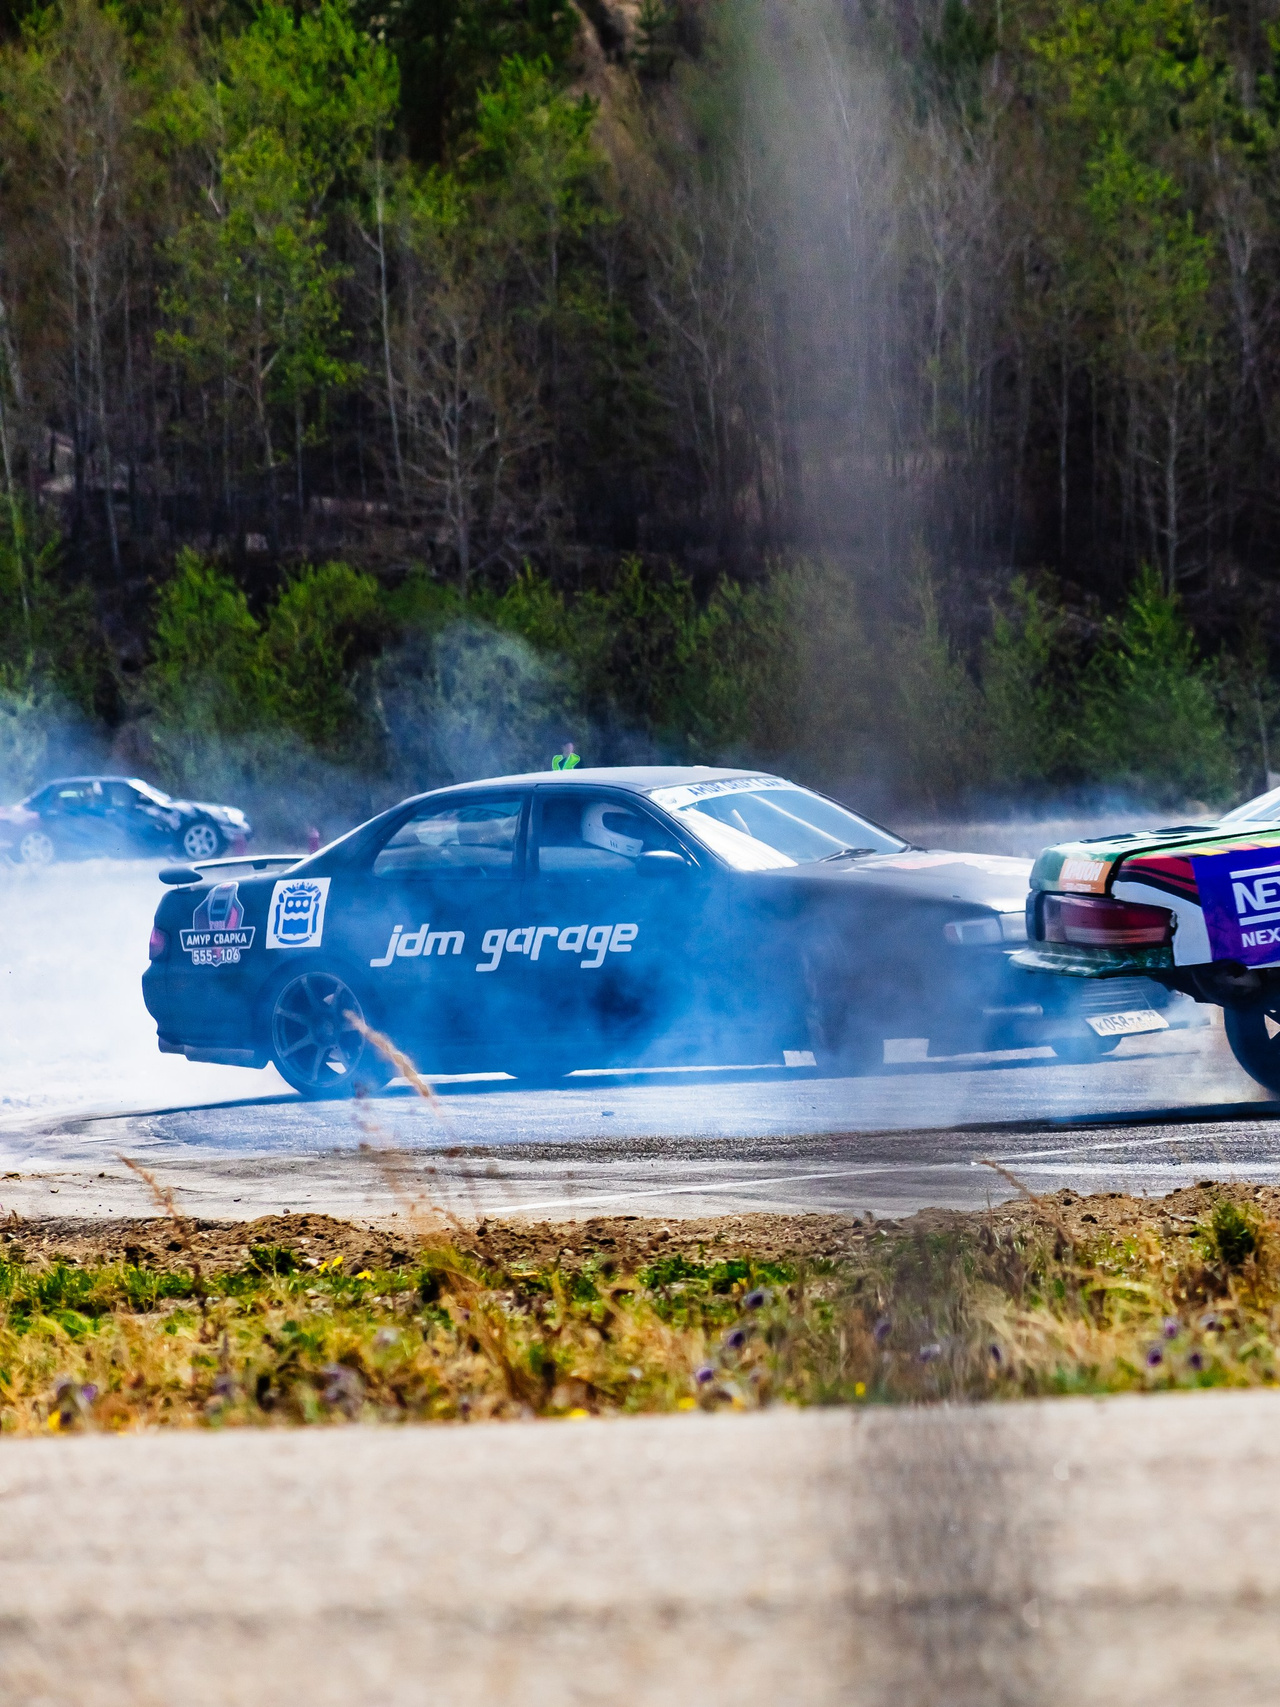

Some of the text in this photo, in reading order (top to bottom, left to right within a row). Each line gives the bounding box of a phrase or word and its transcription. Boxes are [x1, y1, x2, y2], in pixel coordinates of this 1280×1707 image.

[186, 932, 247, 946] АМУР СВАРКА
[370, 923, 639, 972] jdm garage
